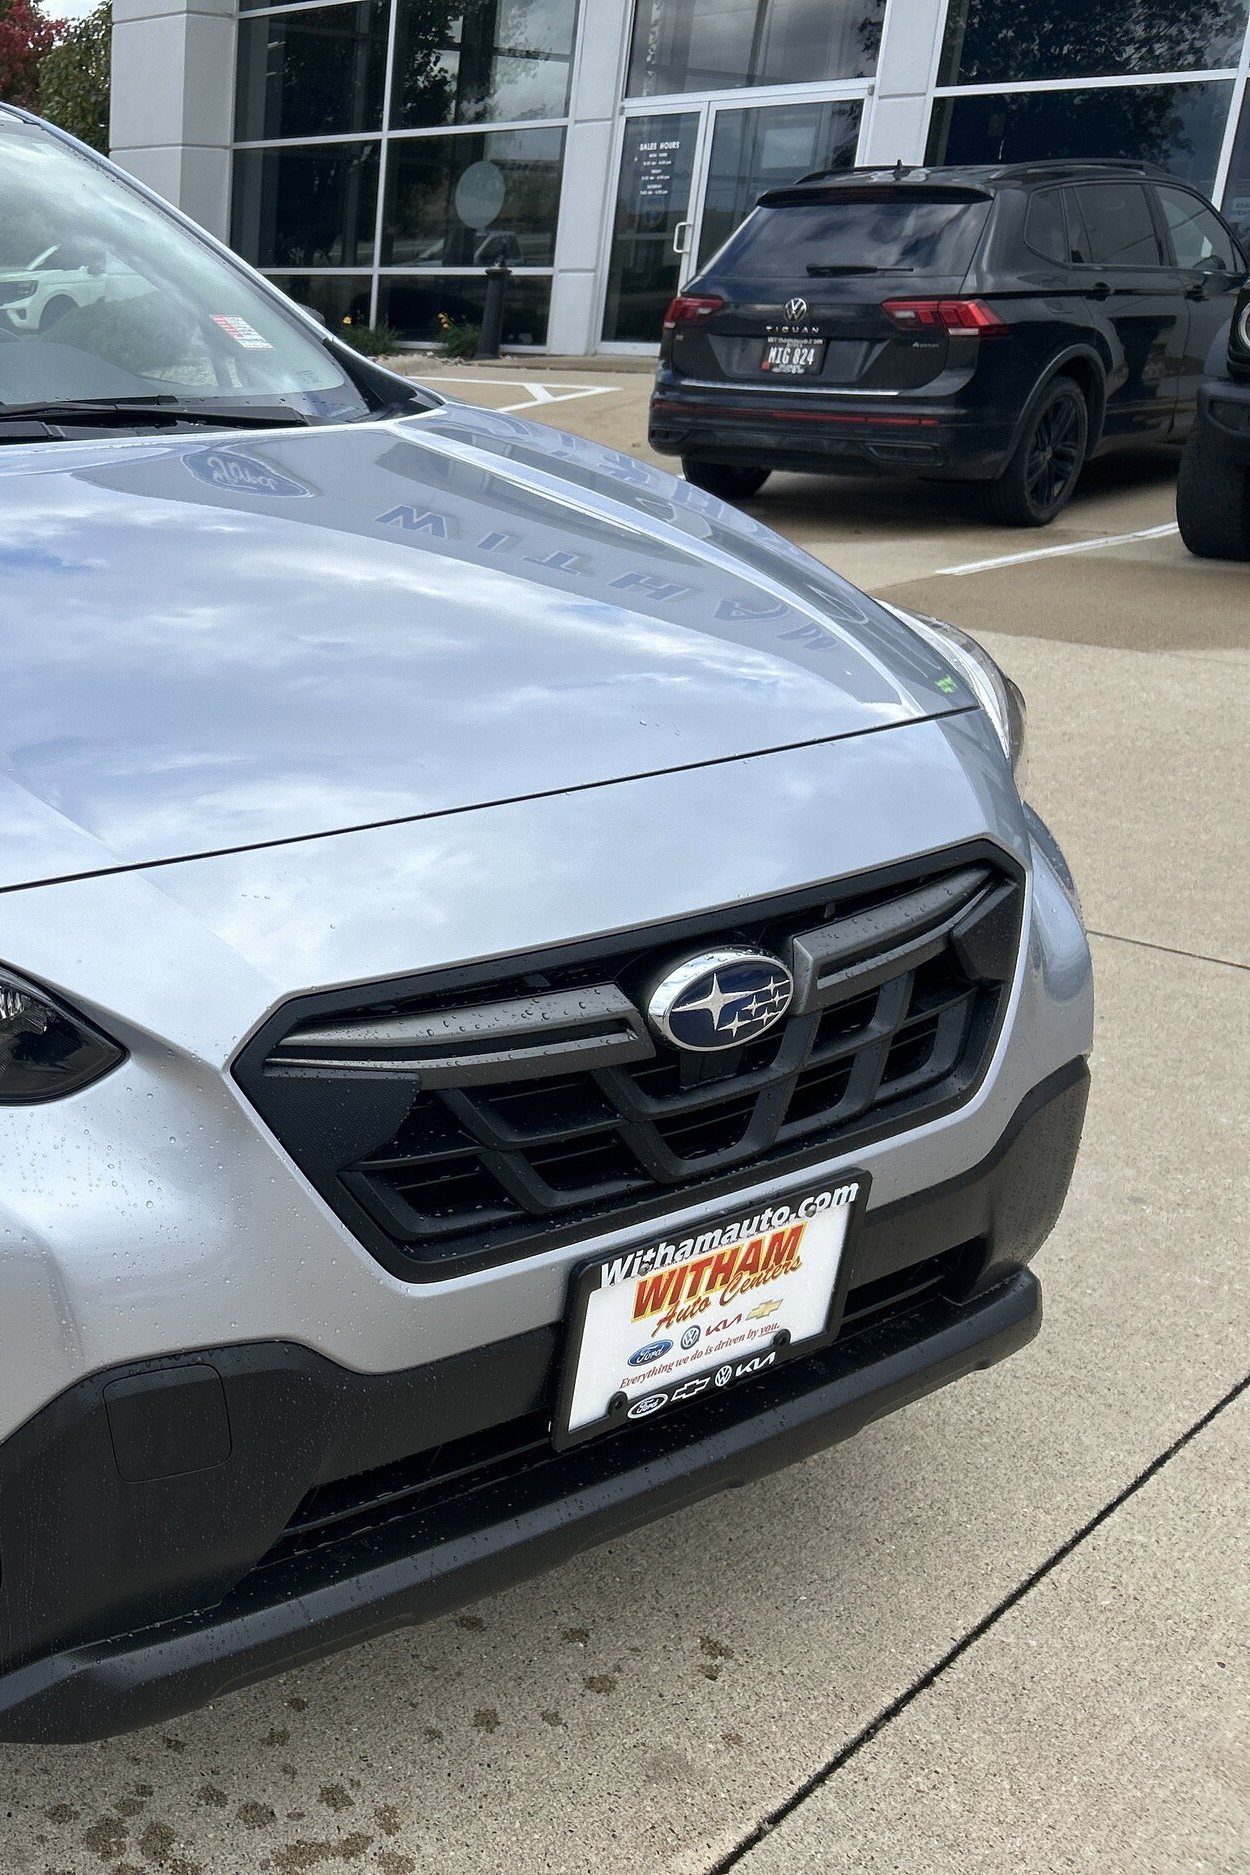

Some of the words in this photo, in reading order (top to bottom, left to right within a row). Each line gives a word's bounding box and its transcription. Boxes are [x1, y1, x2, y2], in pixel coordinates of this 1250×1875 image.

[639, 142, 658, 151] SALES
[659, 141, 681, 150] HOURS
[766, 325, 820, 334] TIGUAN
[792, 347, 815, 365] 824
[601, 1182, 859, 1288] Withamauto.com
[631, 1221, 808, 1323] WITHAM
[651, 1296, 711, 1338] Auto
[719, 1255, 803, 1306] Centers
[619, 1361, 675, 1389] Everything
[675, 1355, 690, 1367] we
[690, 1350, 703, 1361] do
[705, 1346, 714, 1357] is
[714, 1334, 746, 1352] driven
[747, 1328, 760, 1339] by
